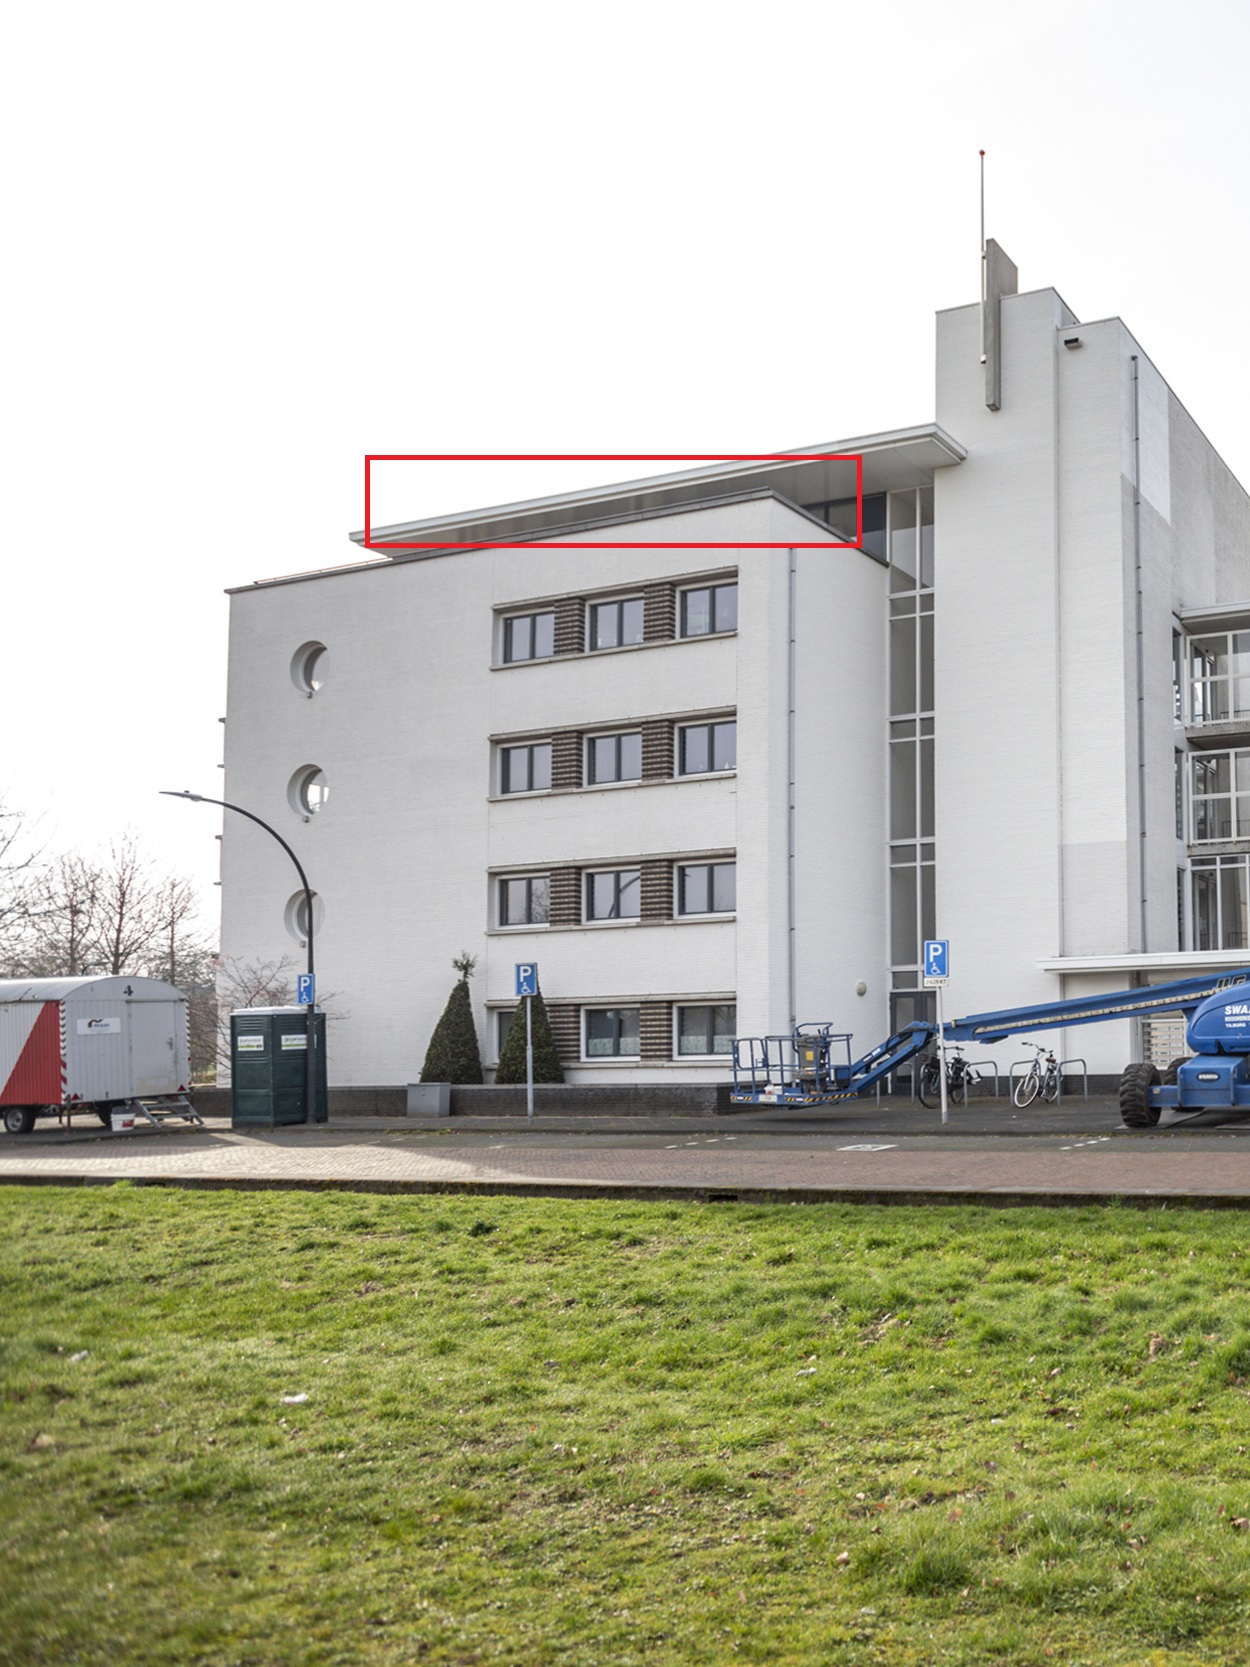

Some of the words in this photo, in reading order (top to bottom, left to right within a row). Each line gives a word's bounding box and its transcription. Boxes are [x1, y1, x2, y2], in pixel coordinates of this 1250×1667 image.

[929, 944, 943, 962] P
[519, 966, 532, 982] P
[123, 985, 133, 996] 4
[300, 976, 310, 992] P
